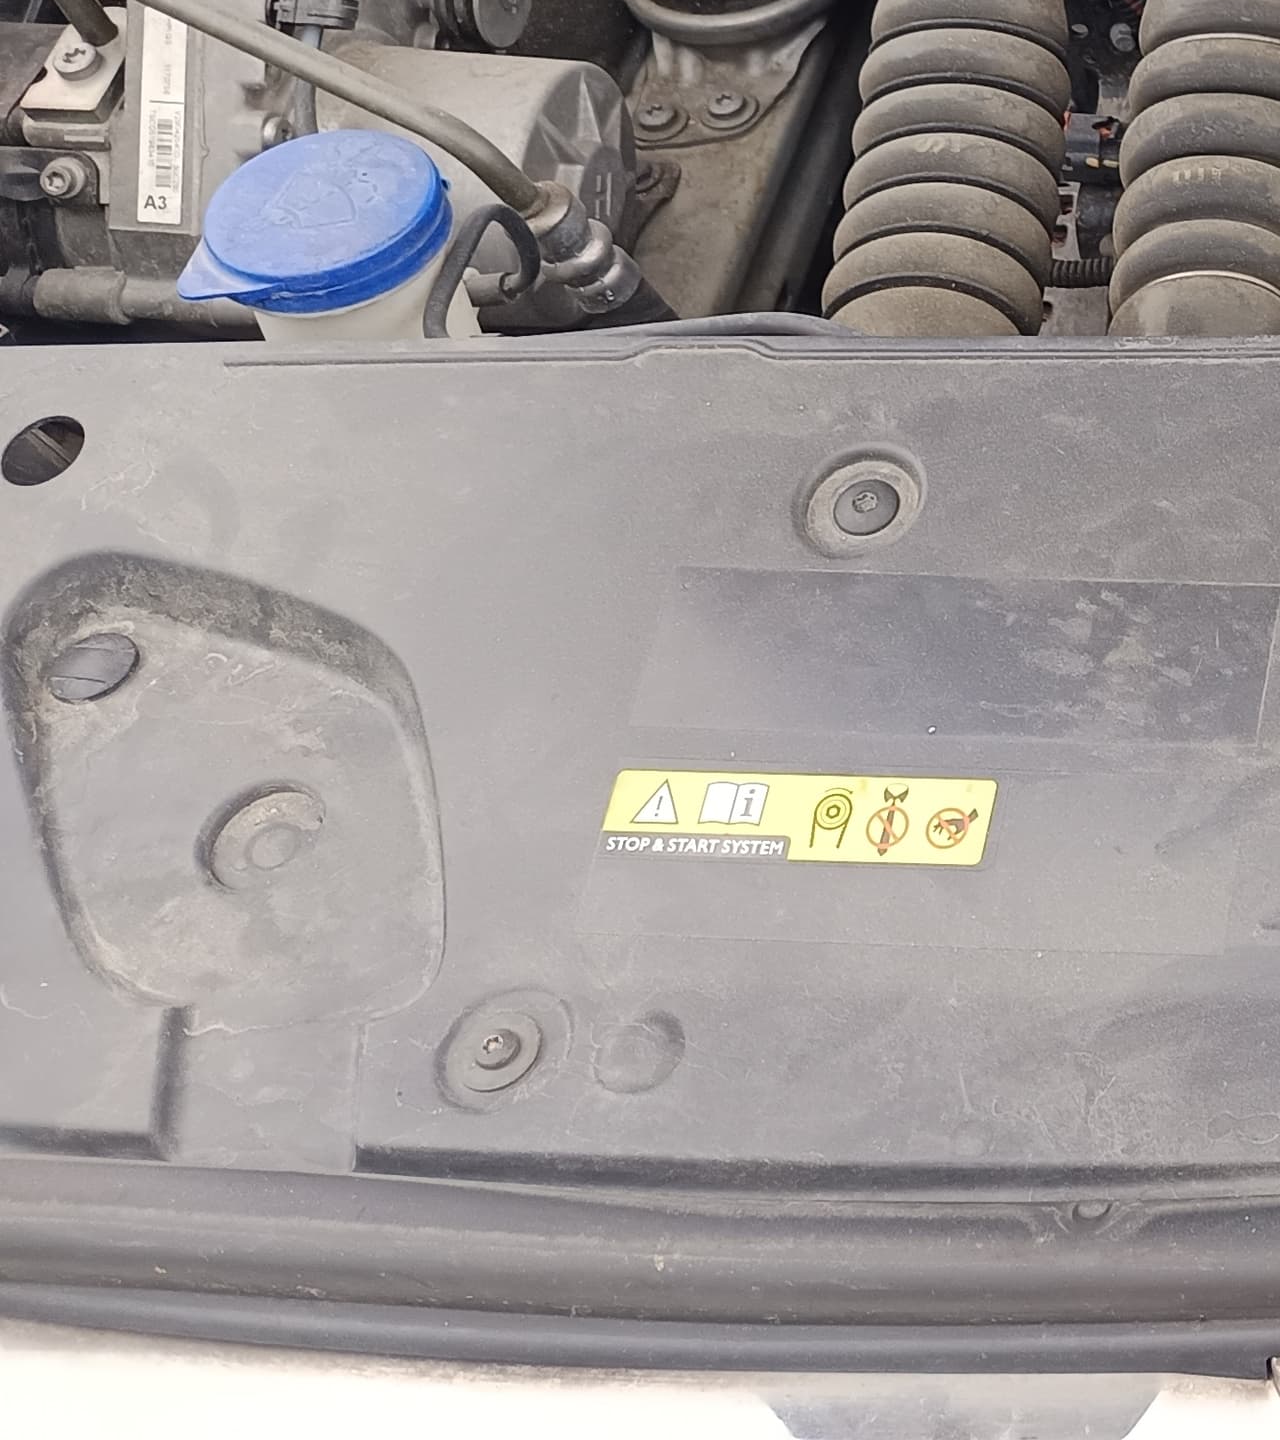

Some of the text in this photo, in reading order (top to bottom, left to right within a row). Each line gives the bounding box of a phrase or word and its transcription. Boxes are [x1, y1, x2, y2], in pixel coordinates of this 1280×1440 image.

[144, 195, 168, 210] A3
[606, 836, 784, 856] STOP & START SYSTEM
